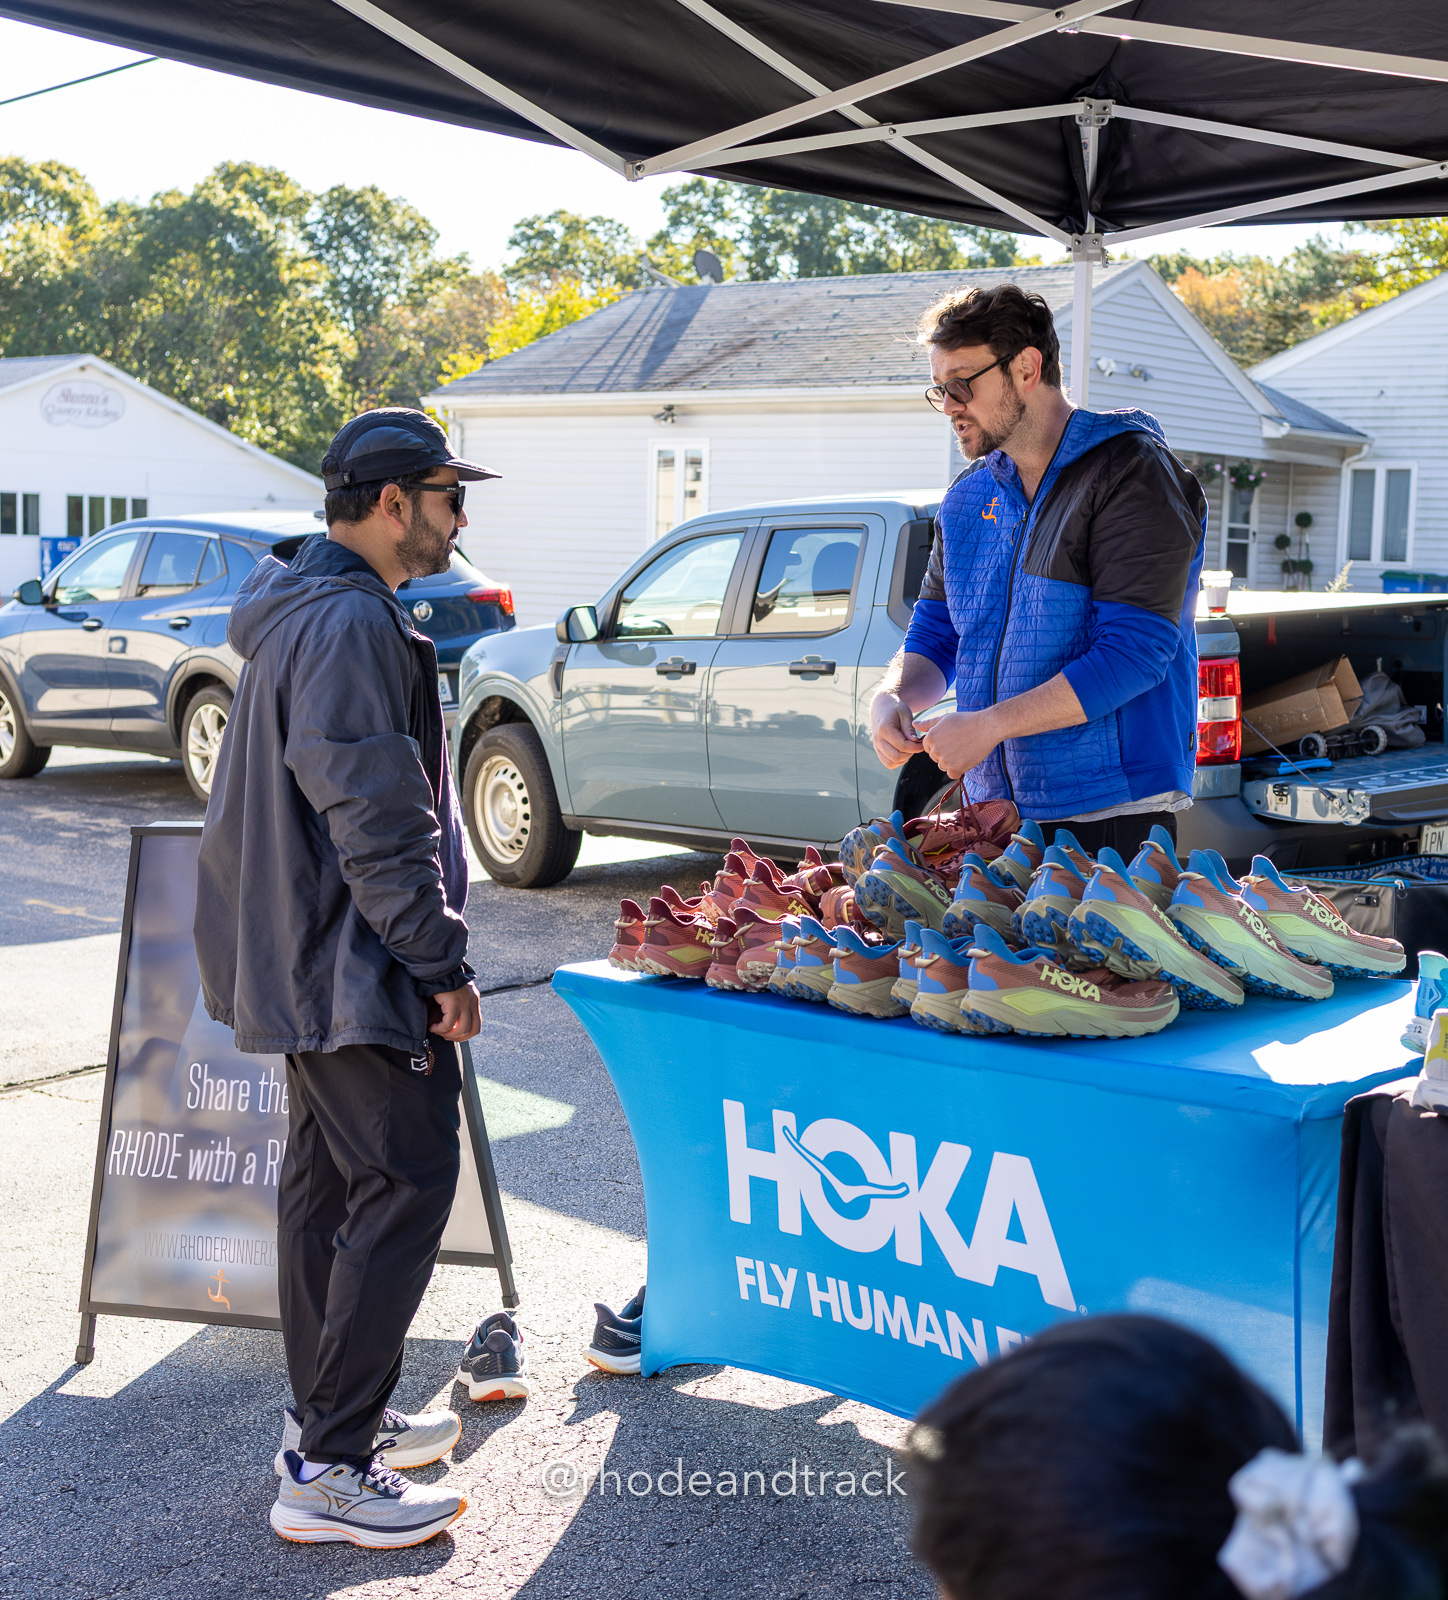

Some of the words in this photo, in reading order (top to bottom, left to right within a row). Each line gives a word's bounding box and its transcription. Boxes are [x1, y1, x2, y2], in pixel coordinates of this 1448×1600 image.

[1239, 905, 1282, 953] HOKA
[1303, 898, 1348, 936] HOKA
[1040, 964, 1101, 1002] HOKA
[187, 1062, 250, 1112] Share
[258, 1067, 289, 1114] the
[108, 1130, 184, 1179] RHODE
[187, 1136, 237, 1183] with
[242, 1152, 257, 1185] a
[723, 1098, 1077, 1312] HOKA
[735, 1256, 798, 1309] FLY
[806, 1272, 989, 1367] HUMAN
